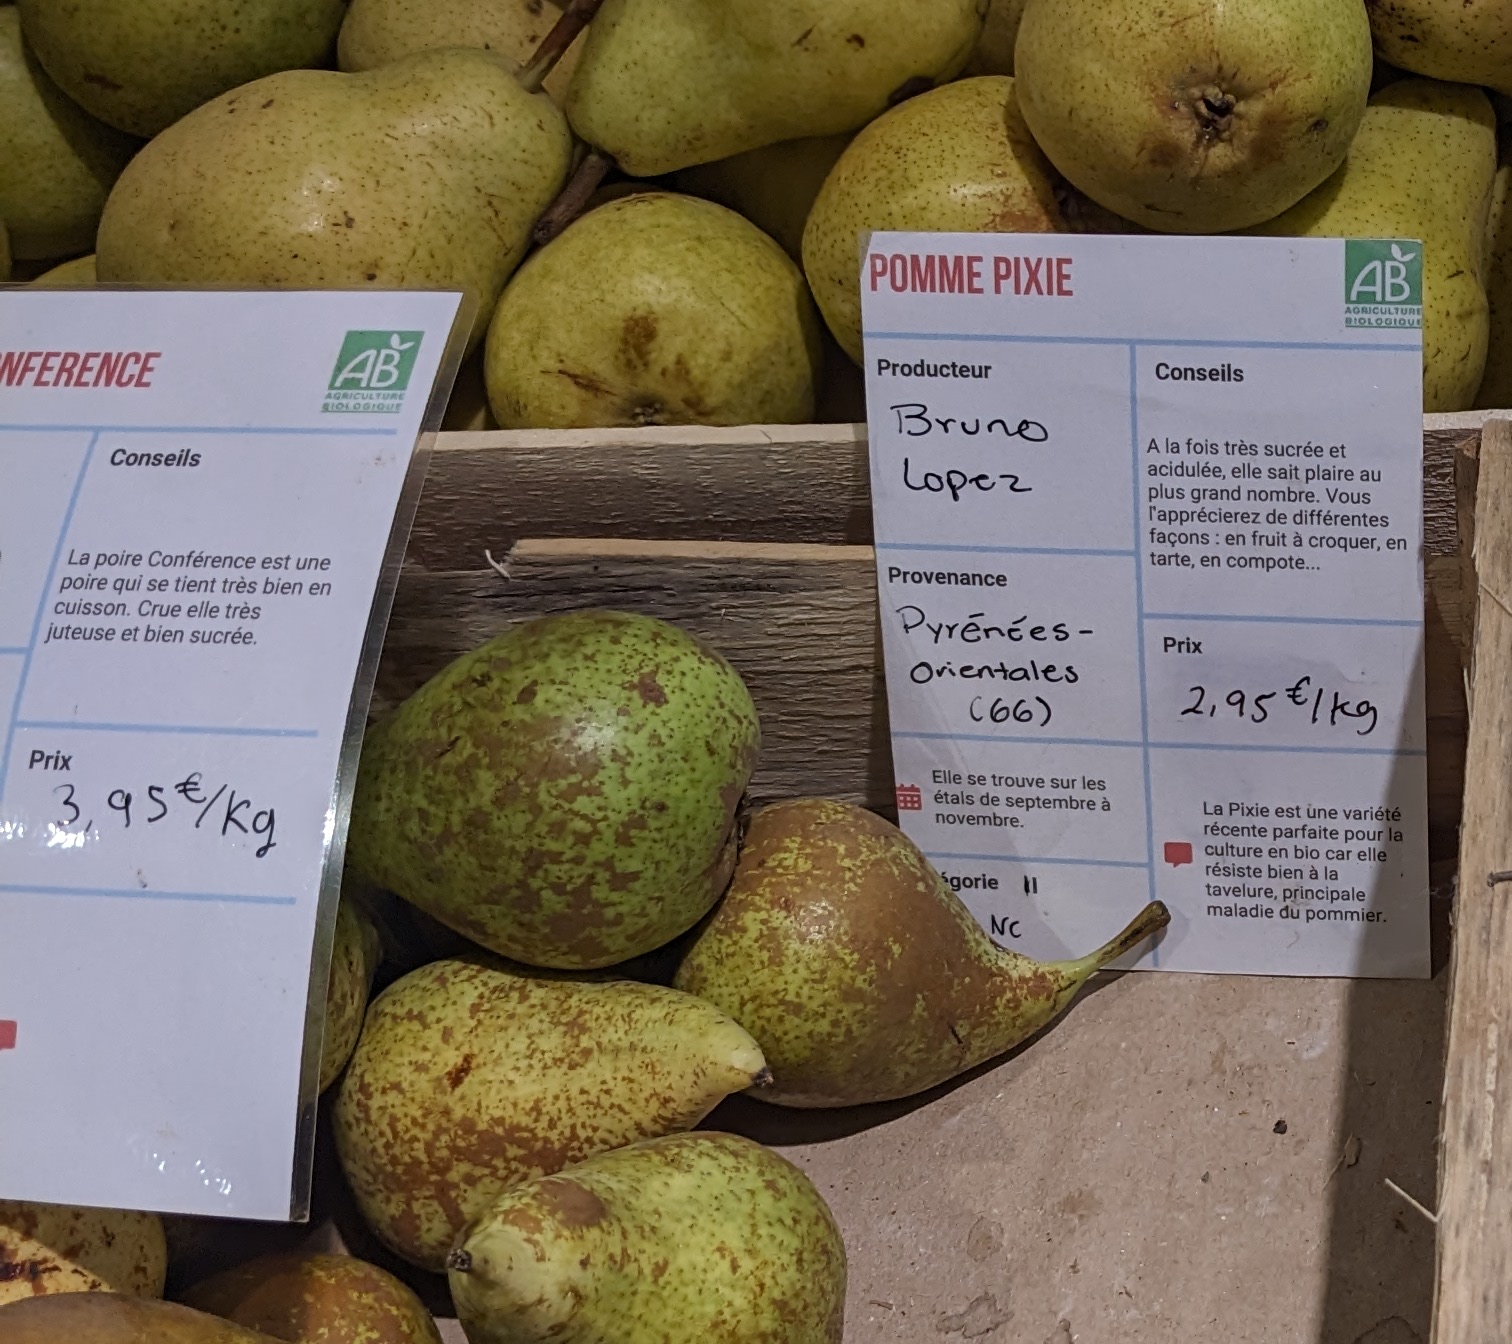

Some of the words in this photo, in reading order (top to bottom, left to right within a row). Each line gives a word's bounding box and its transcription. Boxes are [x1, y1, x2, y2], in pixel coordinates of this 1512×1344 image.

[869, 253, 985, 295] POMME
[993, 256, 1074, 297] PIXIE
[1349, 260, 1411, 302] AB
[0, 351, 162, 388] NFERENCE
[334, 348, 401, 388] AB
[877, 358, 993, 380] Producteur
[1154, 362, 1245, 383] Conseils
[889, 402, 1049, 443] Bruno
[109, 448, 202, 468] Conseils
[1146, 437, 1161, 454] A
[1165, 437, 1181, 455] la
[1185, 437, 1220, 456] fois
[1223, 439, 1259, 457] très
[1263, 440, 1324, 458] sucrée
[1328, 443, 1347, 459] et
[1147, 460, 1227, 481] acidulée,
[1230, 462, 1263, 480] elle
[1267, 463, 1301, 481] sait
[1304, 464, 1355, 485] plaire
[1359, 469, 1382, 483] au
[1148, 482, 1186, 503] plus
[1190, 484, 1242, 504] grand
[1246, 485, 1320, 504] nombre.
[1325, 487, 1372, 505] Vous
[1148, 505, 1262, 526] l'apprécierez
[1265, 508, 1288, 525] de
[1292, 508, 1390, 528] différentes
[67, 548, 91, 566] La
[93, 549, 143, 570] poire
[147, 550, 257, 570] Conférence
[260, 554, 292, 571] est
[295, 557, 332, 571] une
[58, 573, 109, 594] poire
[112, 574, 144, 596] qui
[146, 578, 170, 592] se
[174, 575, 217, 594] tient
[221, 575, 258, 595] très
[262, 576, 304, 596] bien
[308, 582, 332, 596] en
[887, 566, 1008, 588] Provenance
[53, 598, 131, 617] cuisson.
[137, 599, 182, 618] Crue
[186, 600, 220, 619] elle
[225, 601, 262, 620] très
[43, 622, 116, 644] juteuse
[120, 626, 140, 643] et
[143, 624, 185, 644] bien
[189, 626, 257, 645] sucrée.
[1162, 636, 1203, 655] Prix
[969, 695, 1052, 728] (66)
[28, 749, 73, 771] Prix
[931, 769, 963, 785] Elle
[966, 773, 987, 787] se
[990, 773, 1046, 789] trouve
[1049, 777, 1078, 790] sur
[1081, 775, 1107, 792] les
[933, 789, 976, 806] étals
[979, 791, 1001, 807] de
[1005, 794, 1097, 812] septembre
[1101, 796, 1111, 812] à
[1203, 801, 1224, 816] La
[1228, 801, 1270, 818] Pixie
[1274, 805, 1302, 819] est
[1306, 803, 1339, 820] une
[1342, 805, 1402, 823] variété
[935, 811, 1025, 829] novembre.
[1203, 821, 1268, 838] récente
[1272, 823, 1340, 842] parfaite
[1344, 829, 1384, 844] pour
[1388, 826, 1404, 843] la
